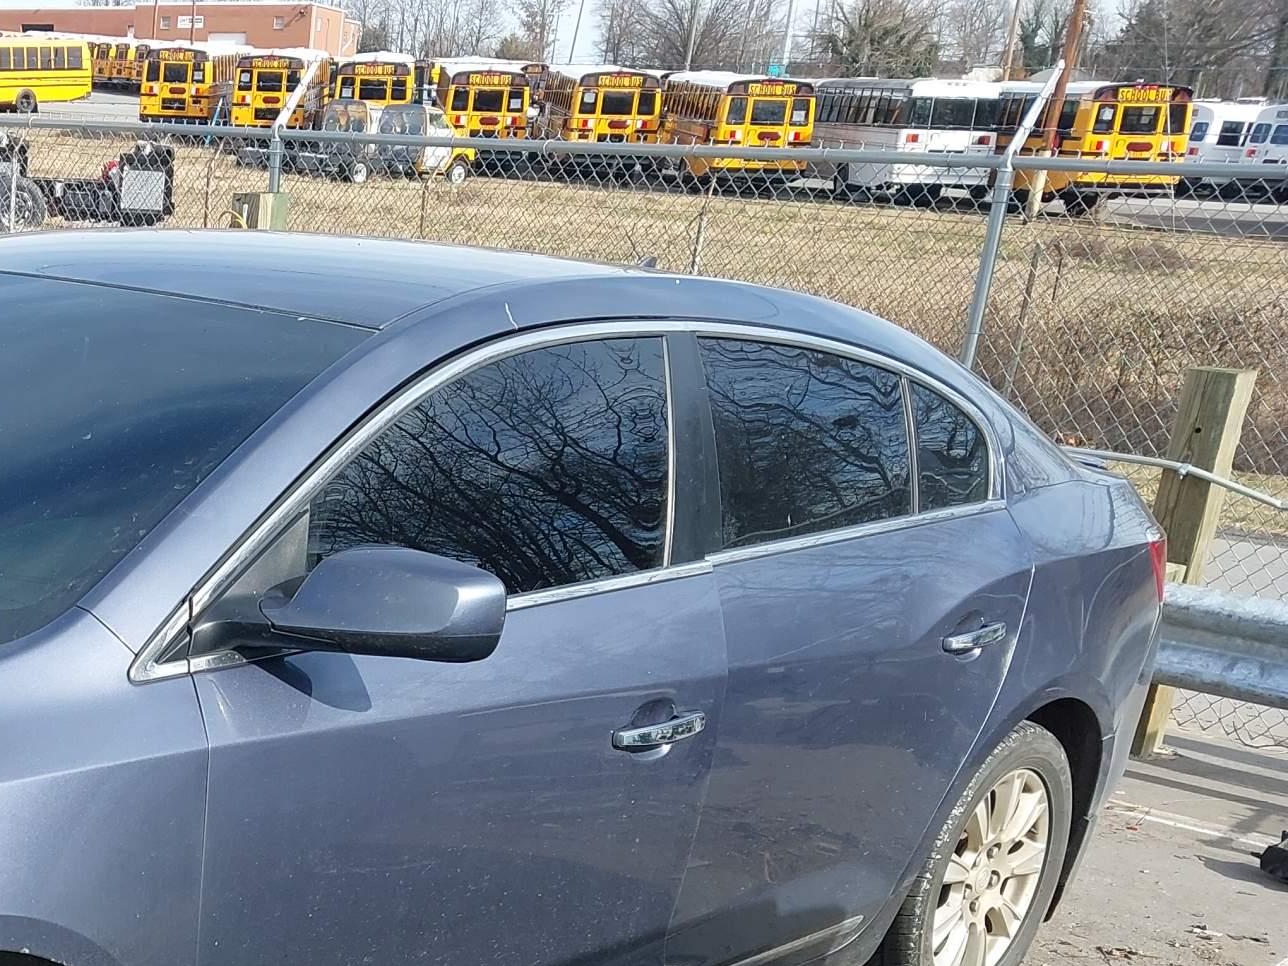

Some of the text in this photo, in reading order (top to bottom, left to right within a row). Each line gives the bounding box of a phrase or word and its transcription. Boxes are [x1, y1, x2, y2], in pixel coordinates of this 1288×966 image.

[749, 85, 796, 95] SCHOOL BUS
[1119, 89, 1152, 101] SCHOOL
